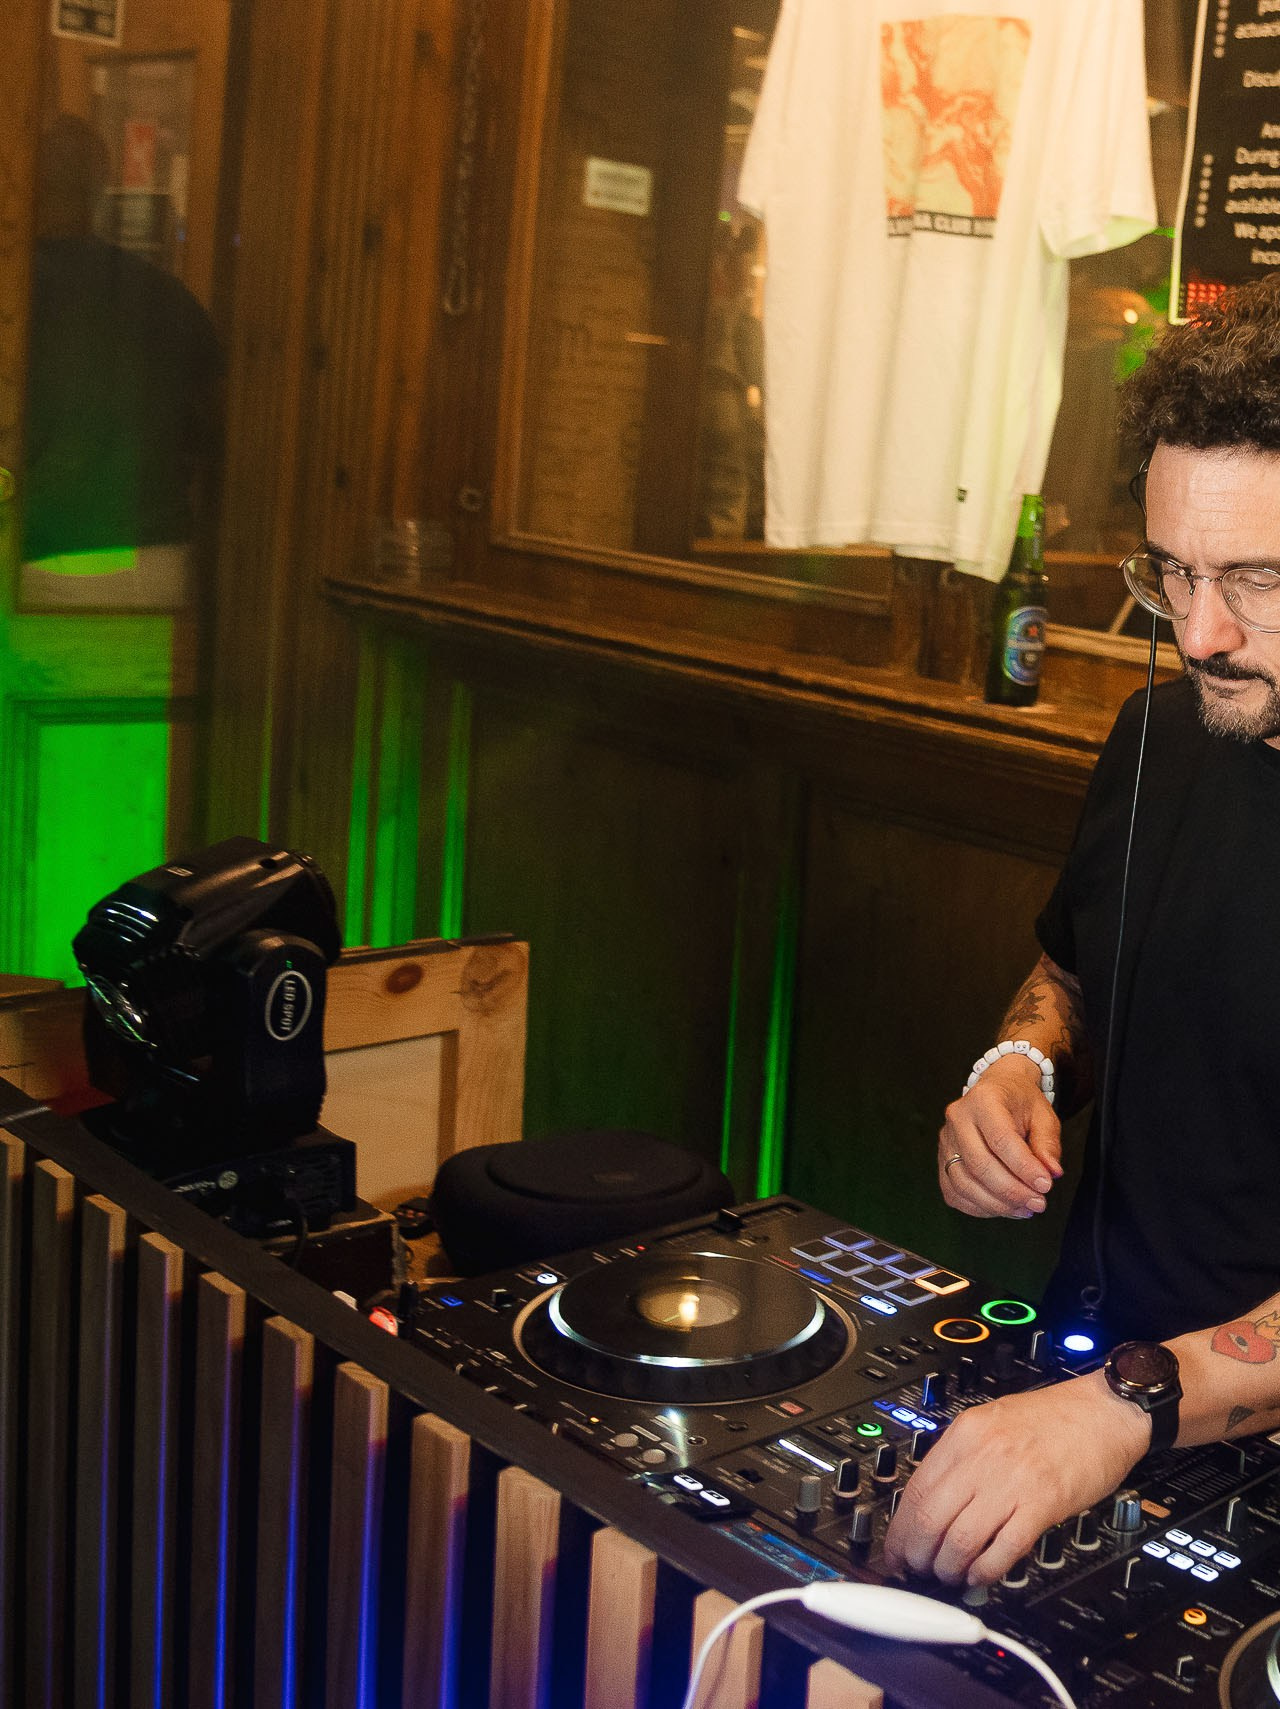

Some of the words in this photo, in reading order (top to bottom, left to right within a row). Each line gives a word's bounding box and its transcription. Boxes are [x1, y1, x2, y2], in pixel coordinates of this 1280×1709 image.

[1235, 146, 1280, 168] During
[1234, 222, 1257, 239] We
[283, 979, 297, 1001] LED
[280, 1003, 295, 1031] SPOT
